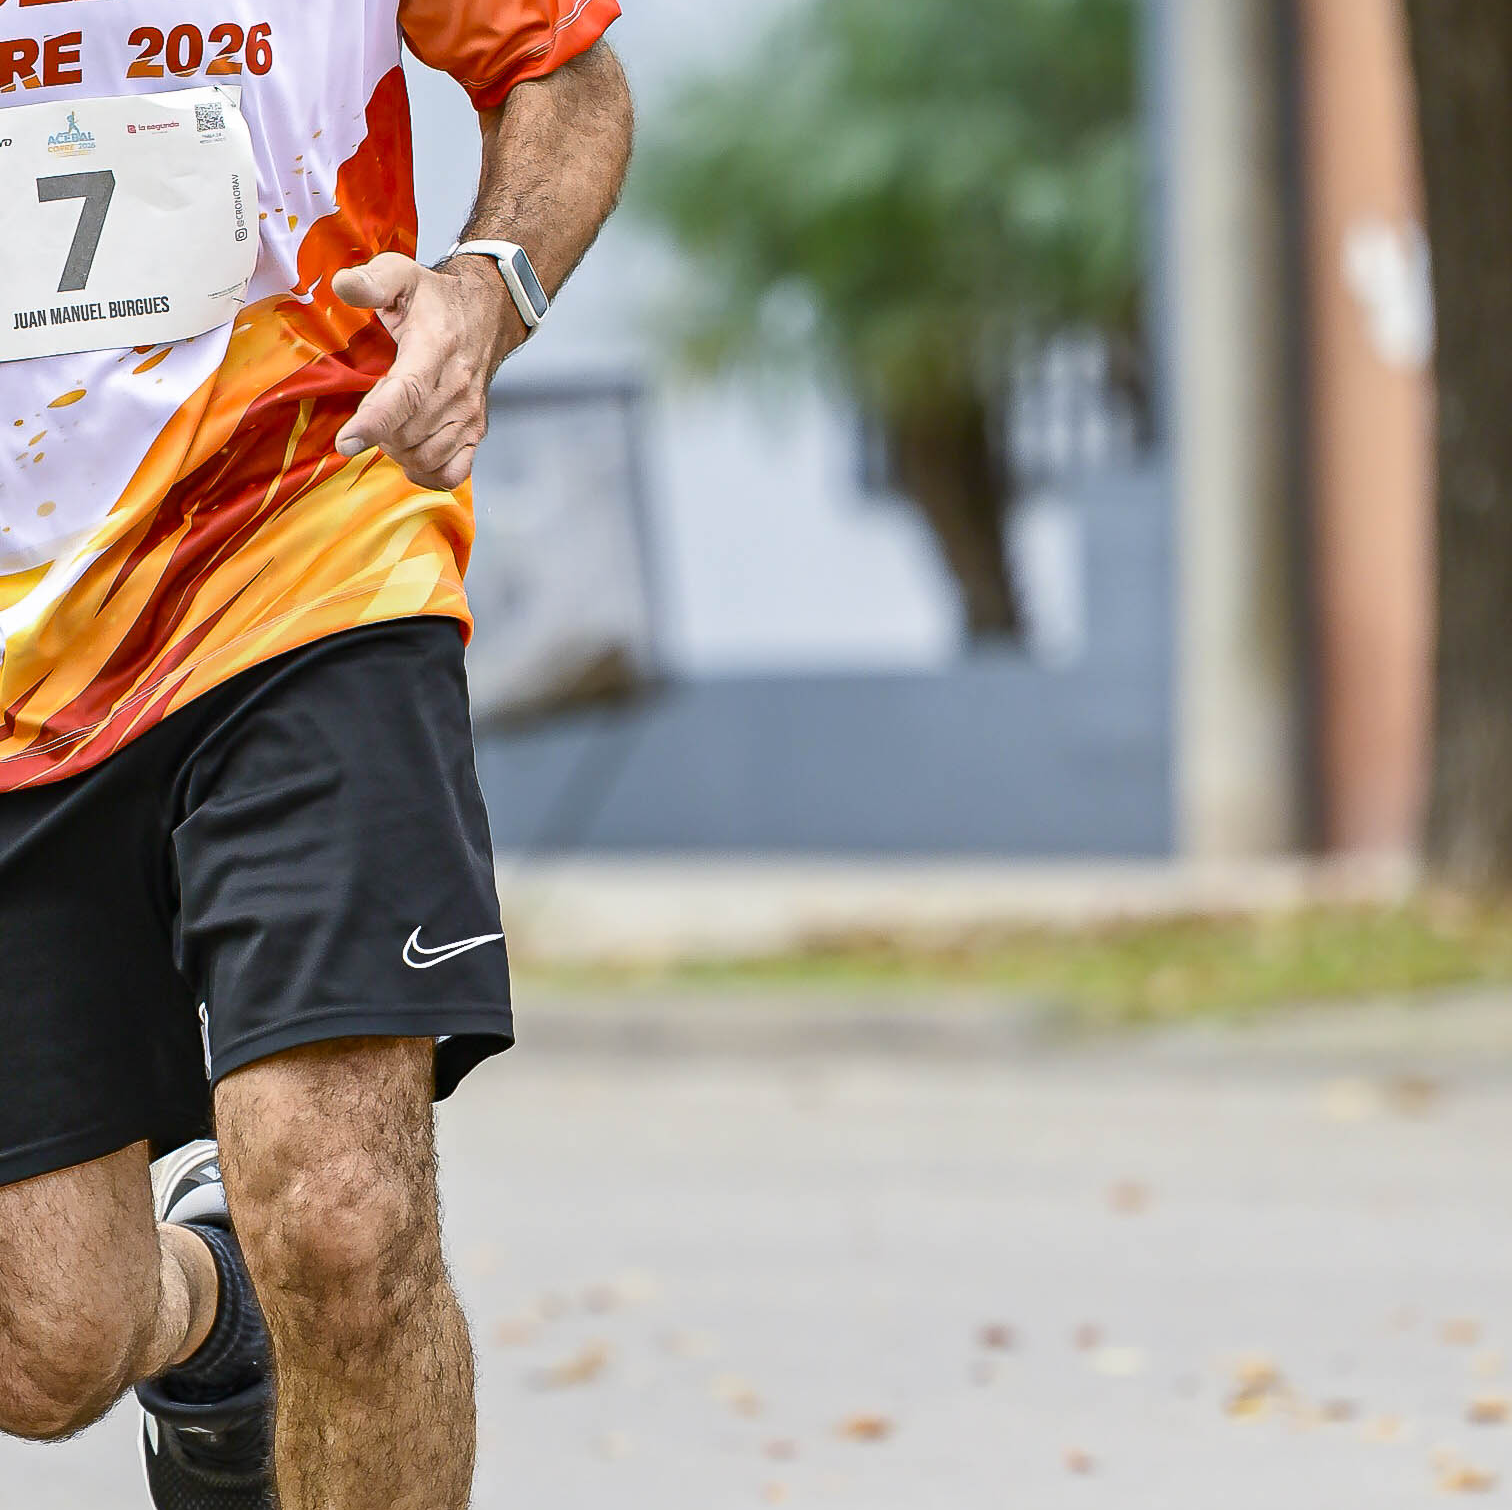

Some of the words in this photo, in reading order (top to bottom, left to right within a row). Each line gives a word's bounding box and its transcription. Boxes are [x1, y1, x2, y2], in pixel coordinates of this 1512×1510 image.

[125, 21, 274, 79] 2026
[48, 131, 95, 145] ACEBAL
[231, 173, 245, 228] @CRONORAV
[35, 169, 116, 293] 7
[13, 309, 47, 330] JUAN
[50, 302, 107, 326] MANUEL
[108, 295, 171, 319] BURGUES
